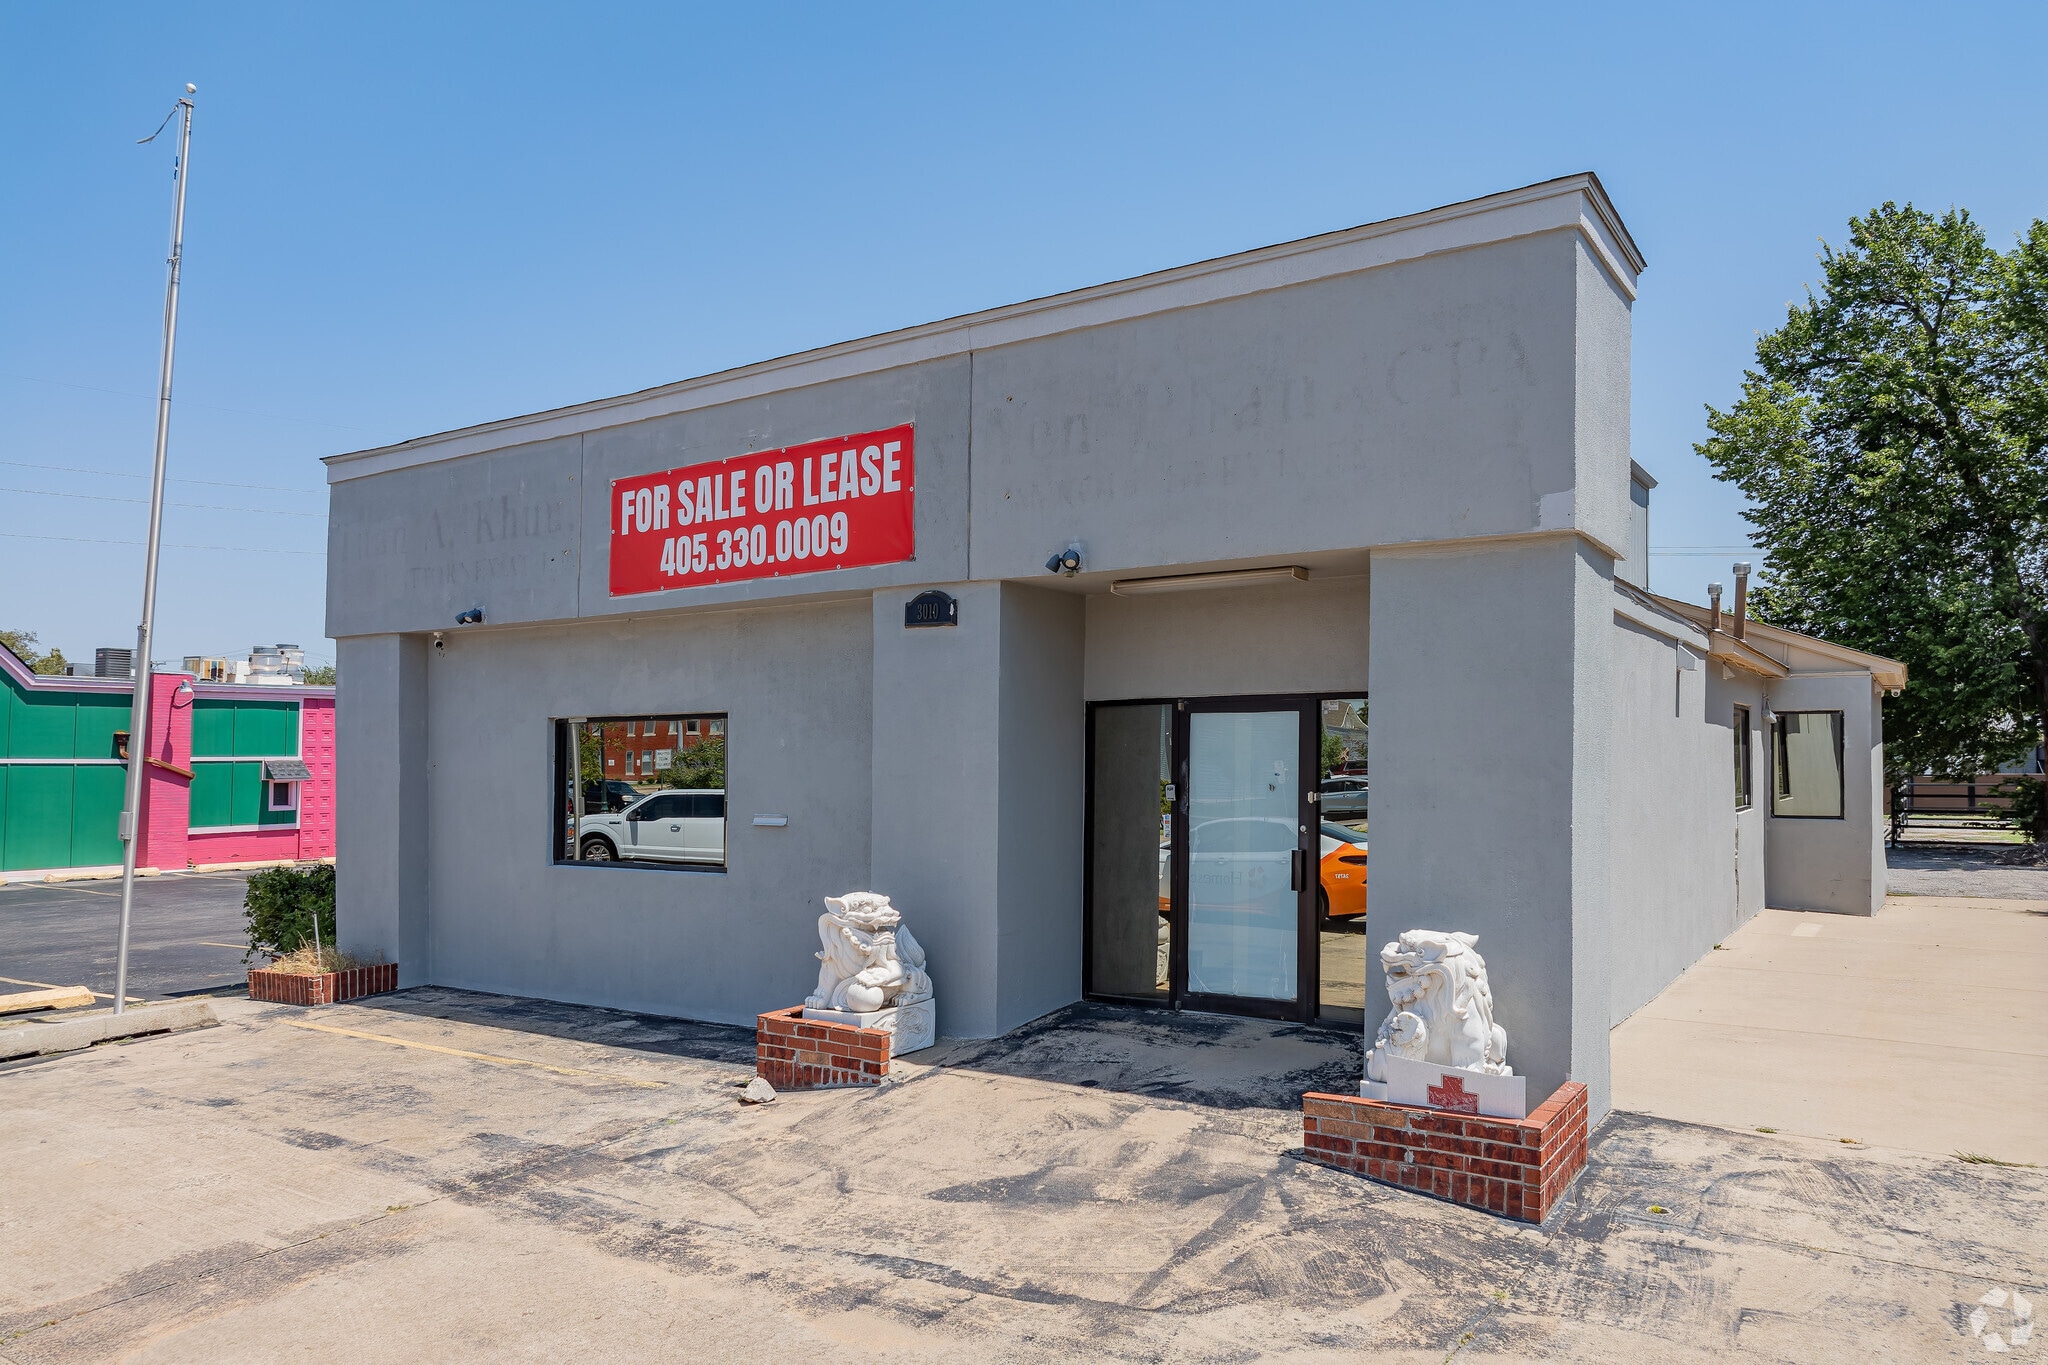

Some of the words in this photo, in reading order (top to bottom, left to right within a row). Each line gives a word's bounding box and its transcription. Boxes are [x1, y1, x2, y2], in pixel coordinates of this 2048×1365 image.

[621, 484, 670, 535] FOR
[678, 469, 746, 526] SALE
[754, 461, 795, 514] OR
[803, 440, 901, 506] LEASE
[660, 511, 848, 577] 405.330.0009
[917, 603, 939, 620] 3010
